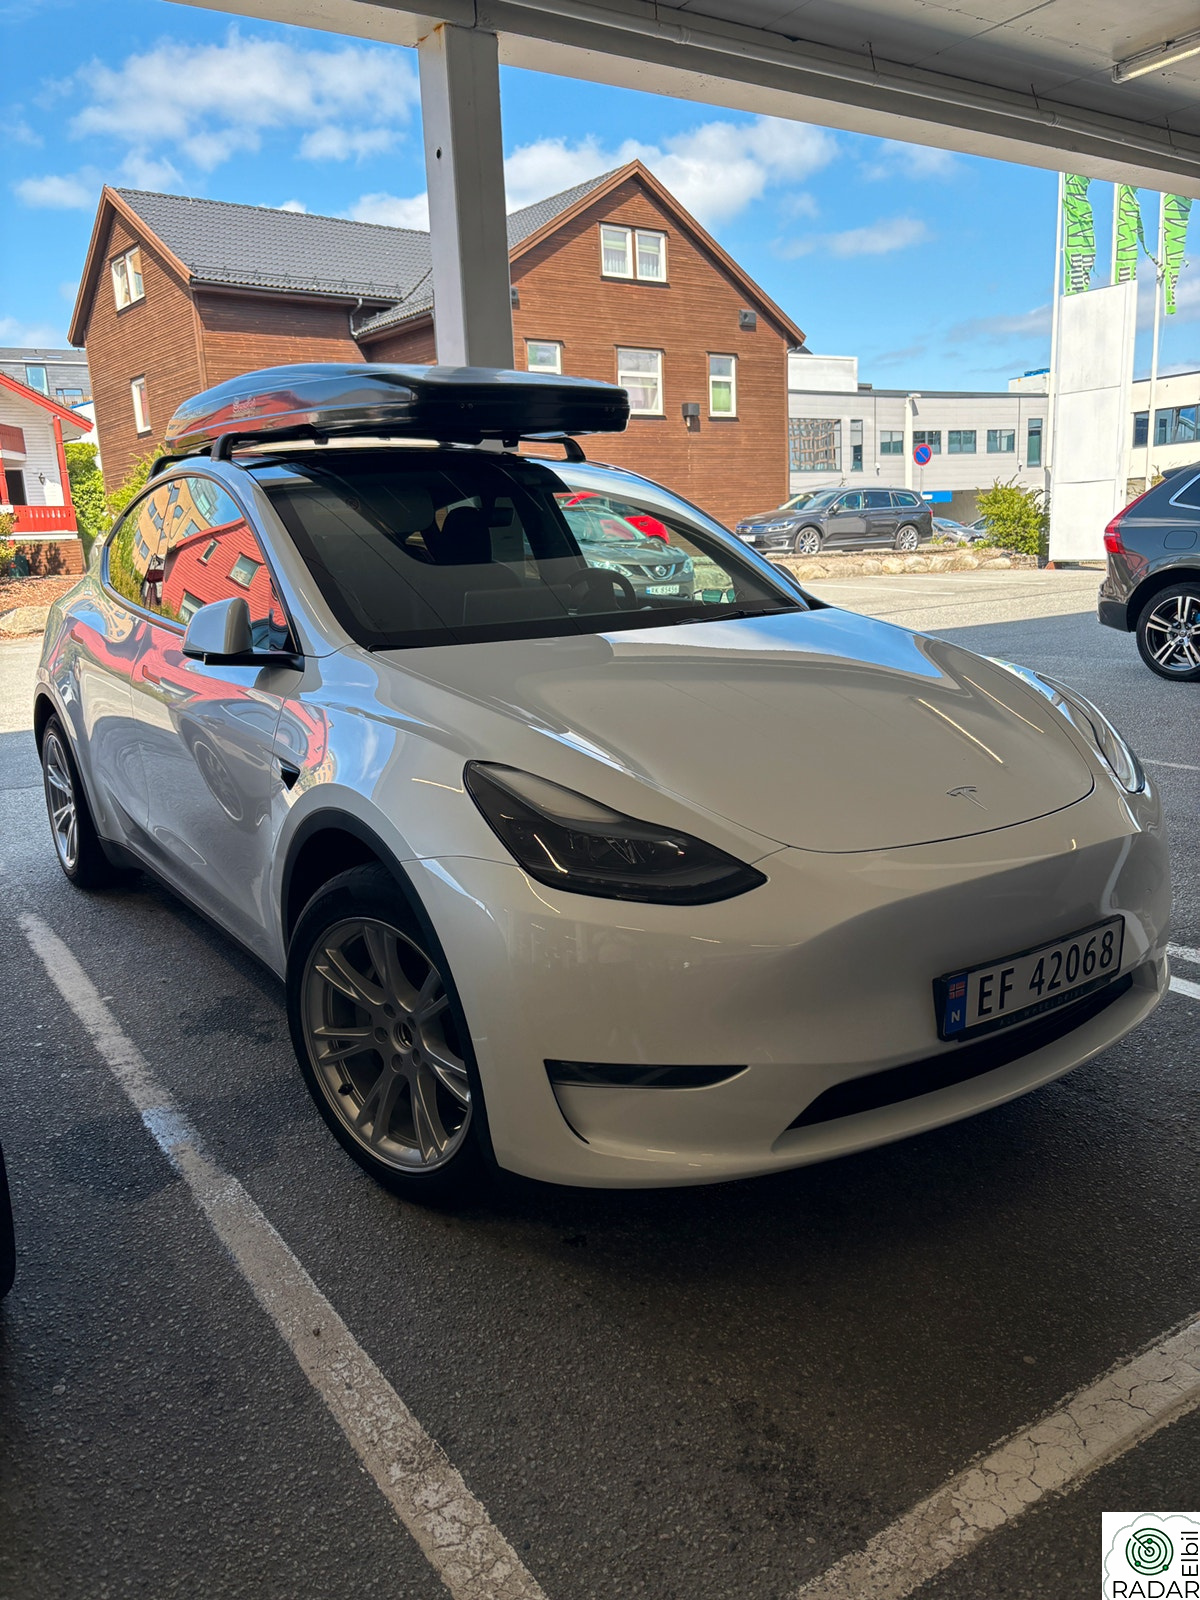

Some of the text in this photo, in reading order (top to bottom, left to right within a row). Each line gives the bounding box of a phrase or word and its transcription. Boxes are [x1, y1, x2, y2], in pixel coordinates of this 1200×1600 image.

[977, 930, 1114, 1017] EF 42068
[951, 1009, 961, 1023] N
